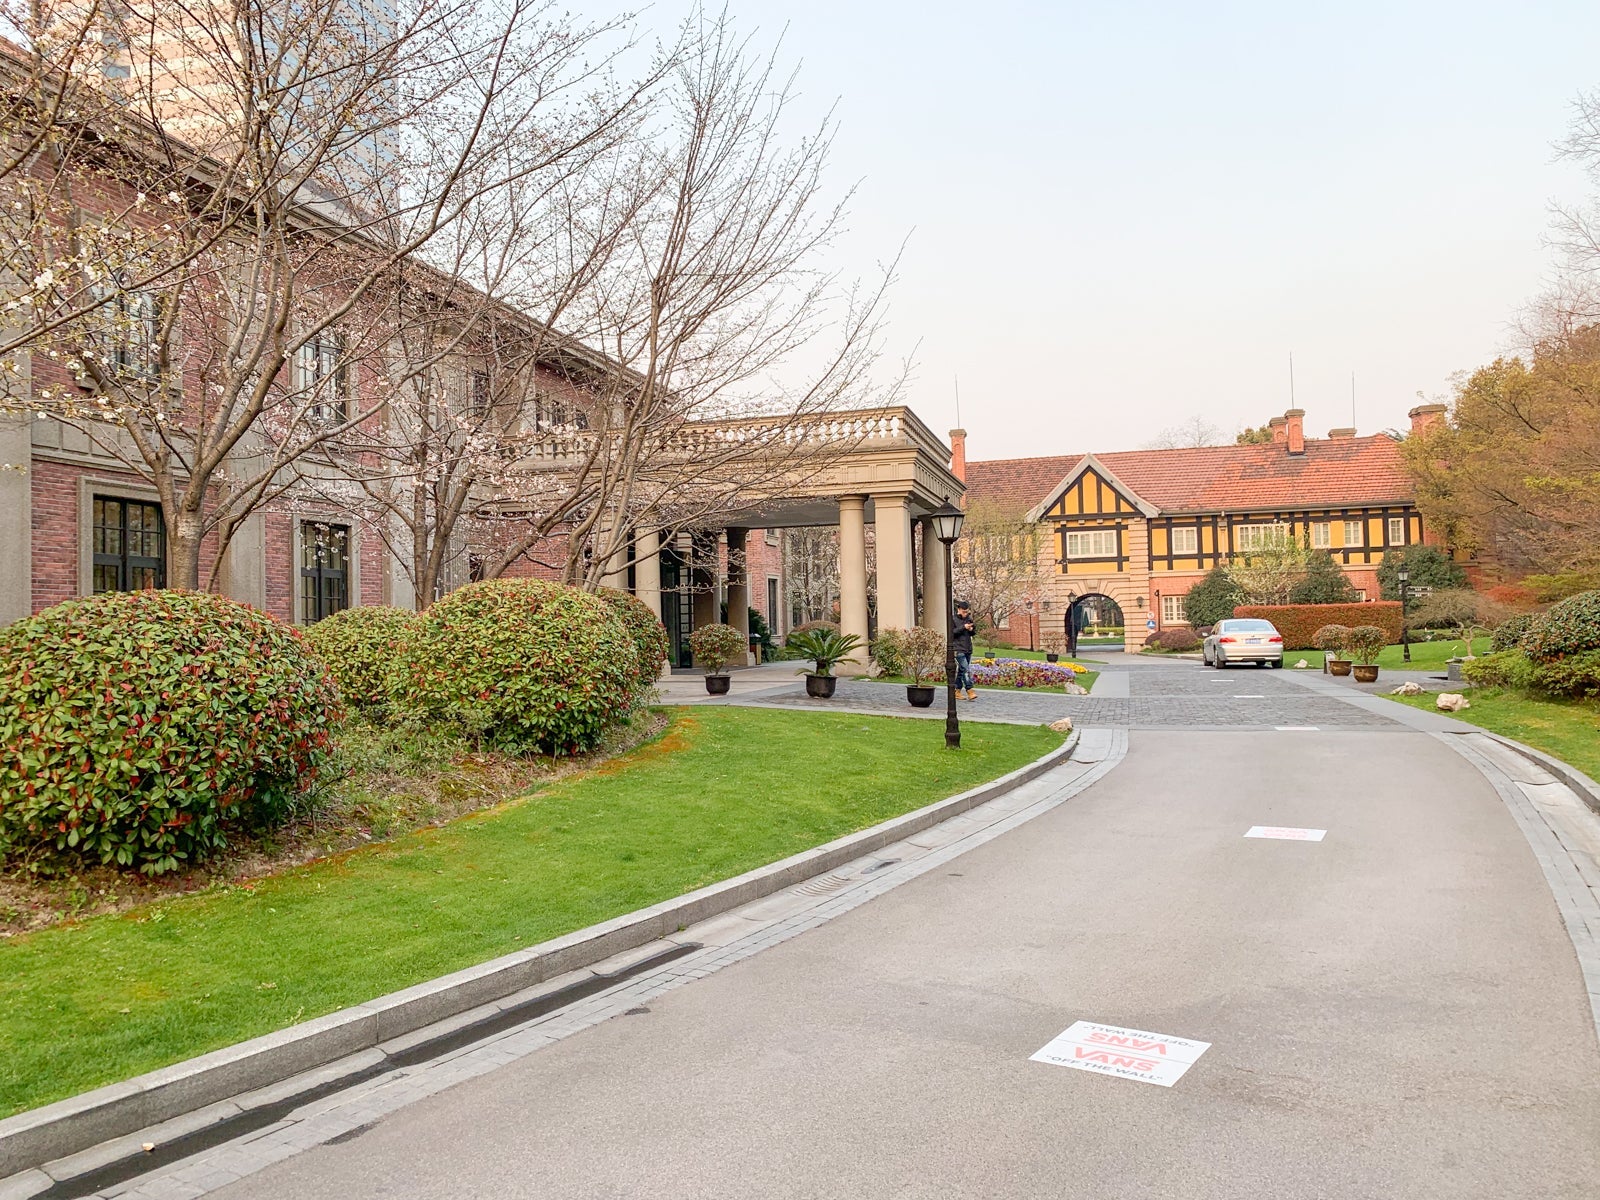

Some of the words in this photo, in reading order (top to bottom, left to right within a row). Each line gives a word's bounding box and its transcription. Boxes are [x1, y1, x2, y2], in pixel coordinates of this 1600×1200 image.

[1083, 1032, 1167, 1055] VANS
[1075, 1047, 1161, 1072] VANS
[1084, 1062, 1112, 1071] THE
